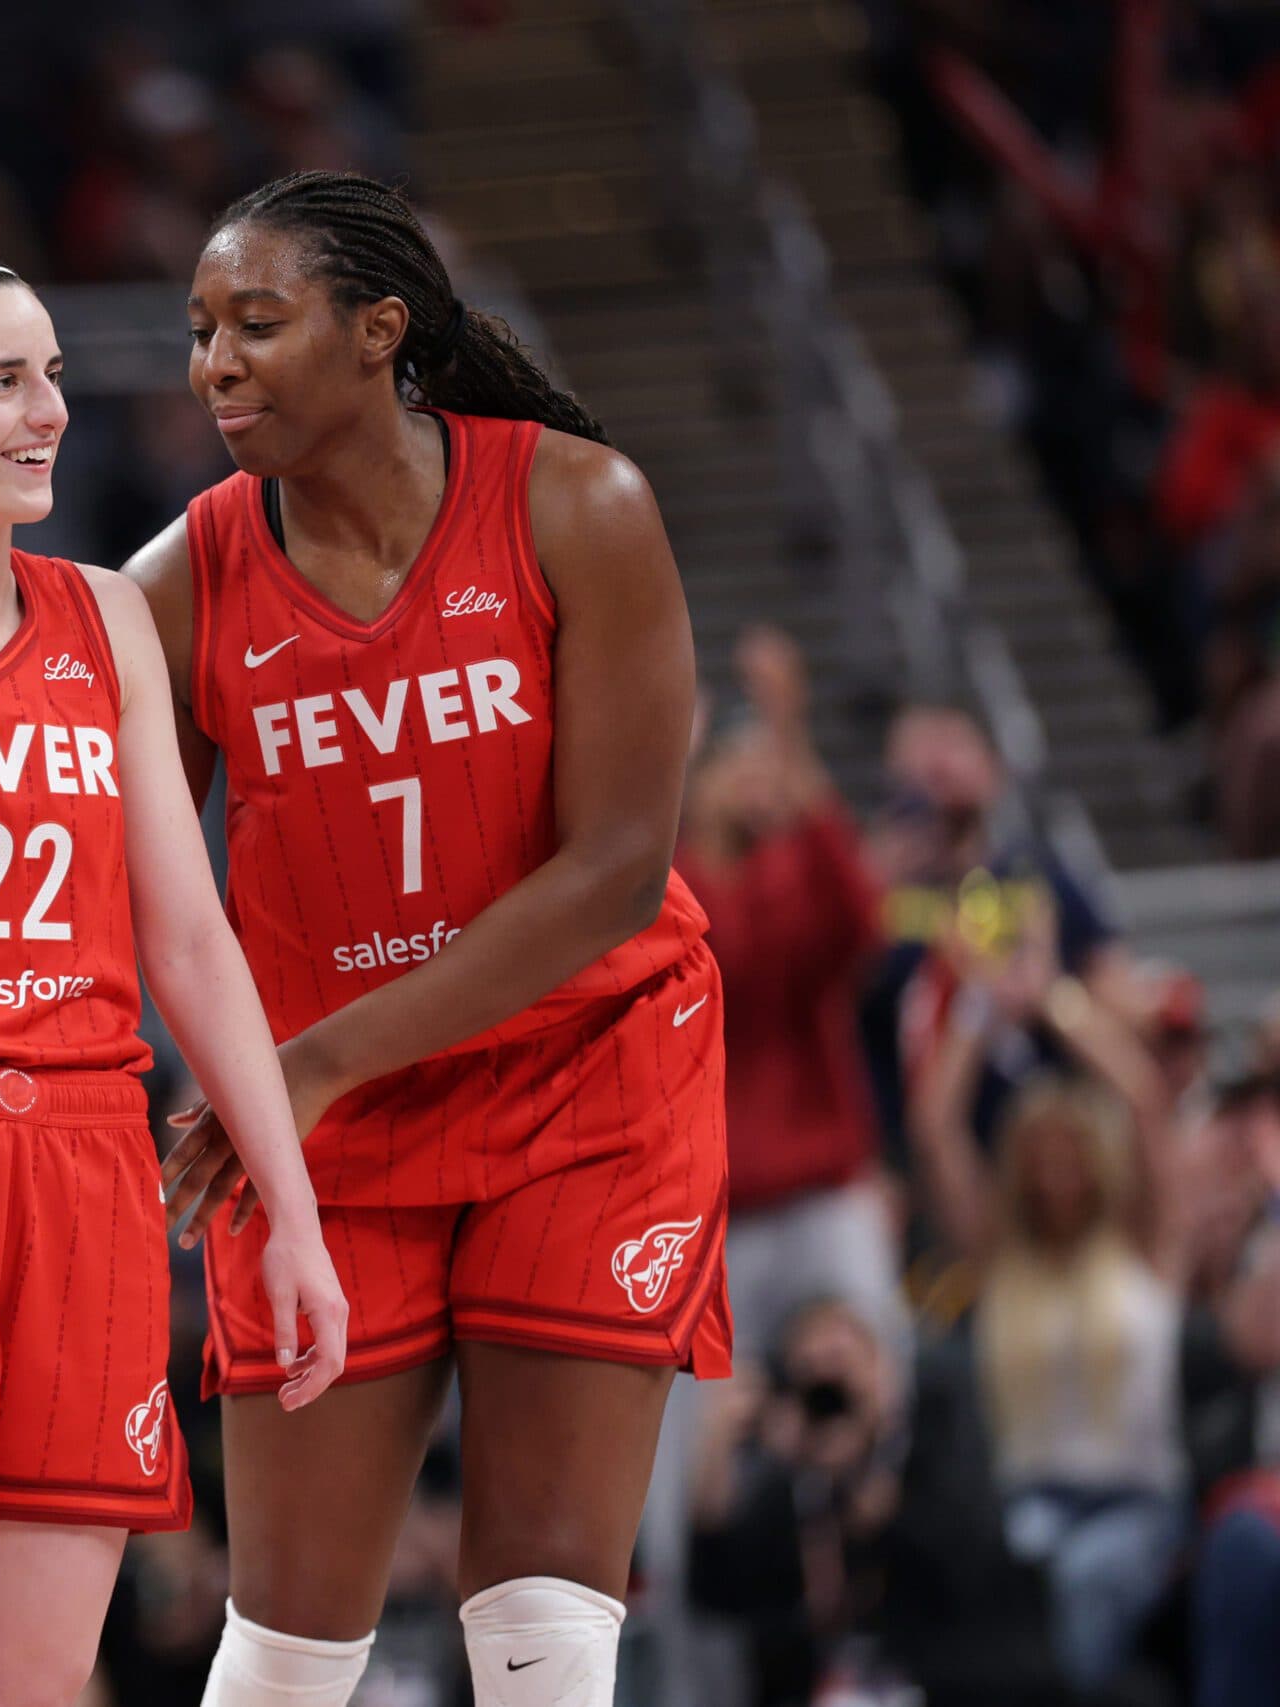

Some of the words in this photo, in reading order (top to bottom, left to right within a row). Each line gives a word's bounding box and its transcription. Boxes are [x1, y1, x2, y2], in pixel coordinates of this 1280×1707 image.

[442, 585, 507, 618] Lilly
[43, 653, 95, 689] Lilly
[252, 658, 532, 776] FEVER
[368, 777, 422, 894] 7
